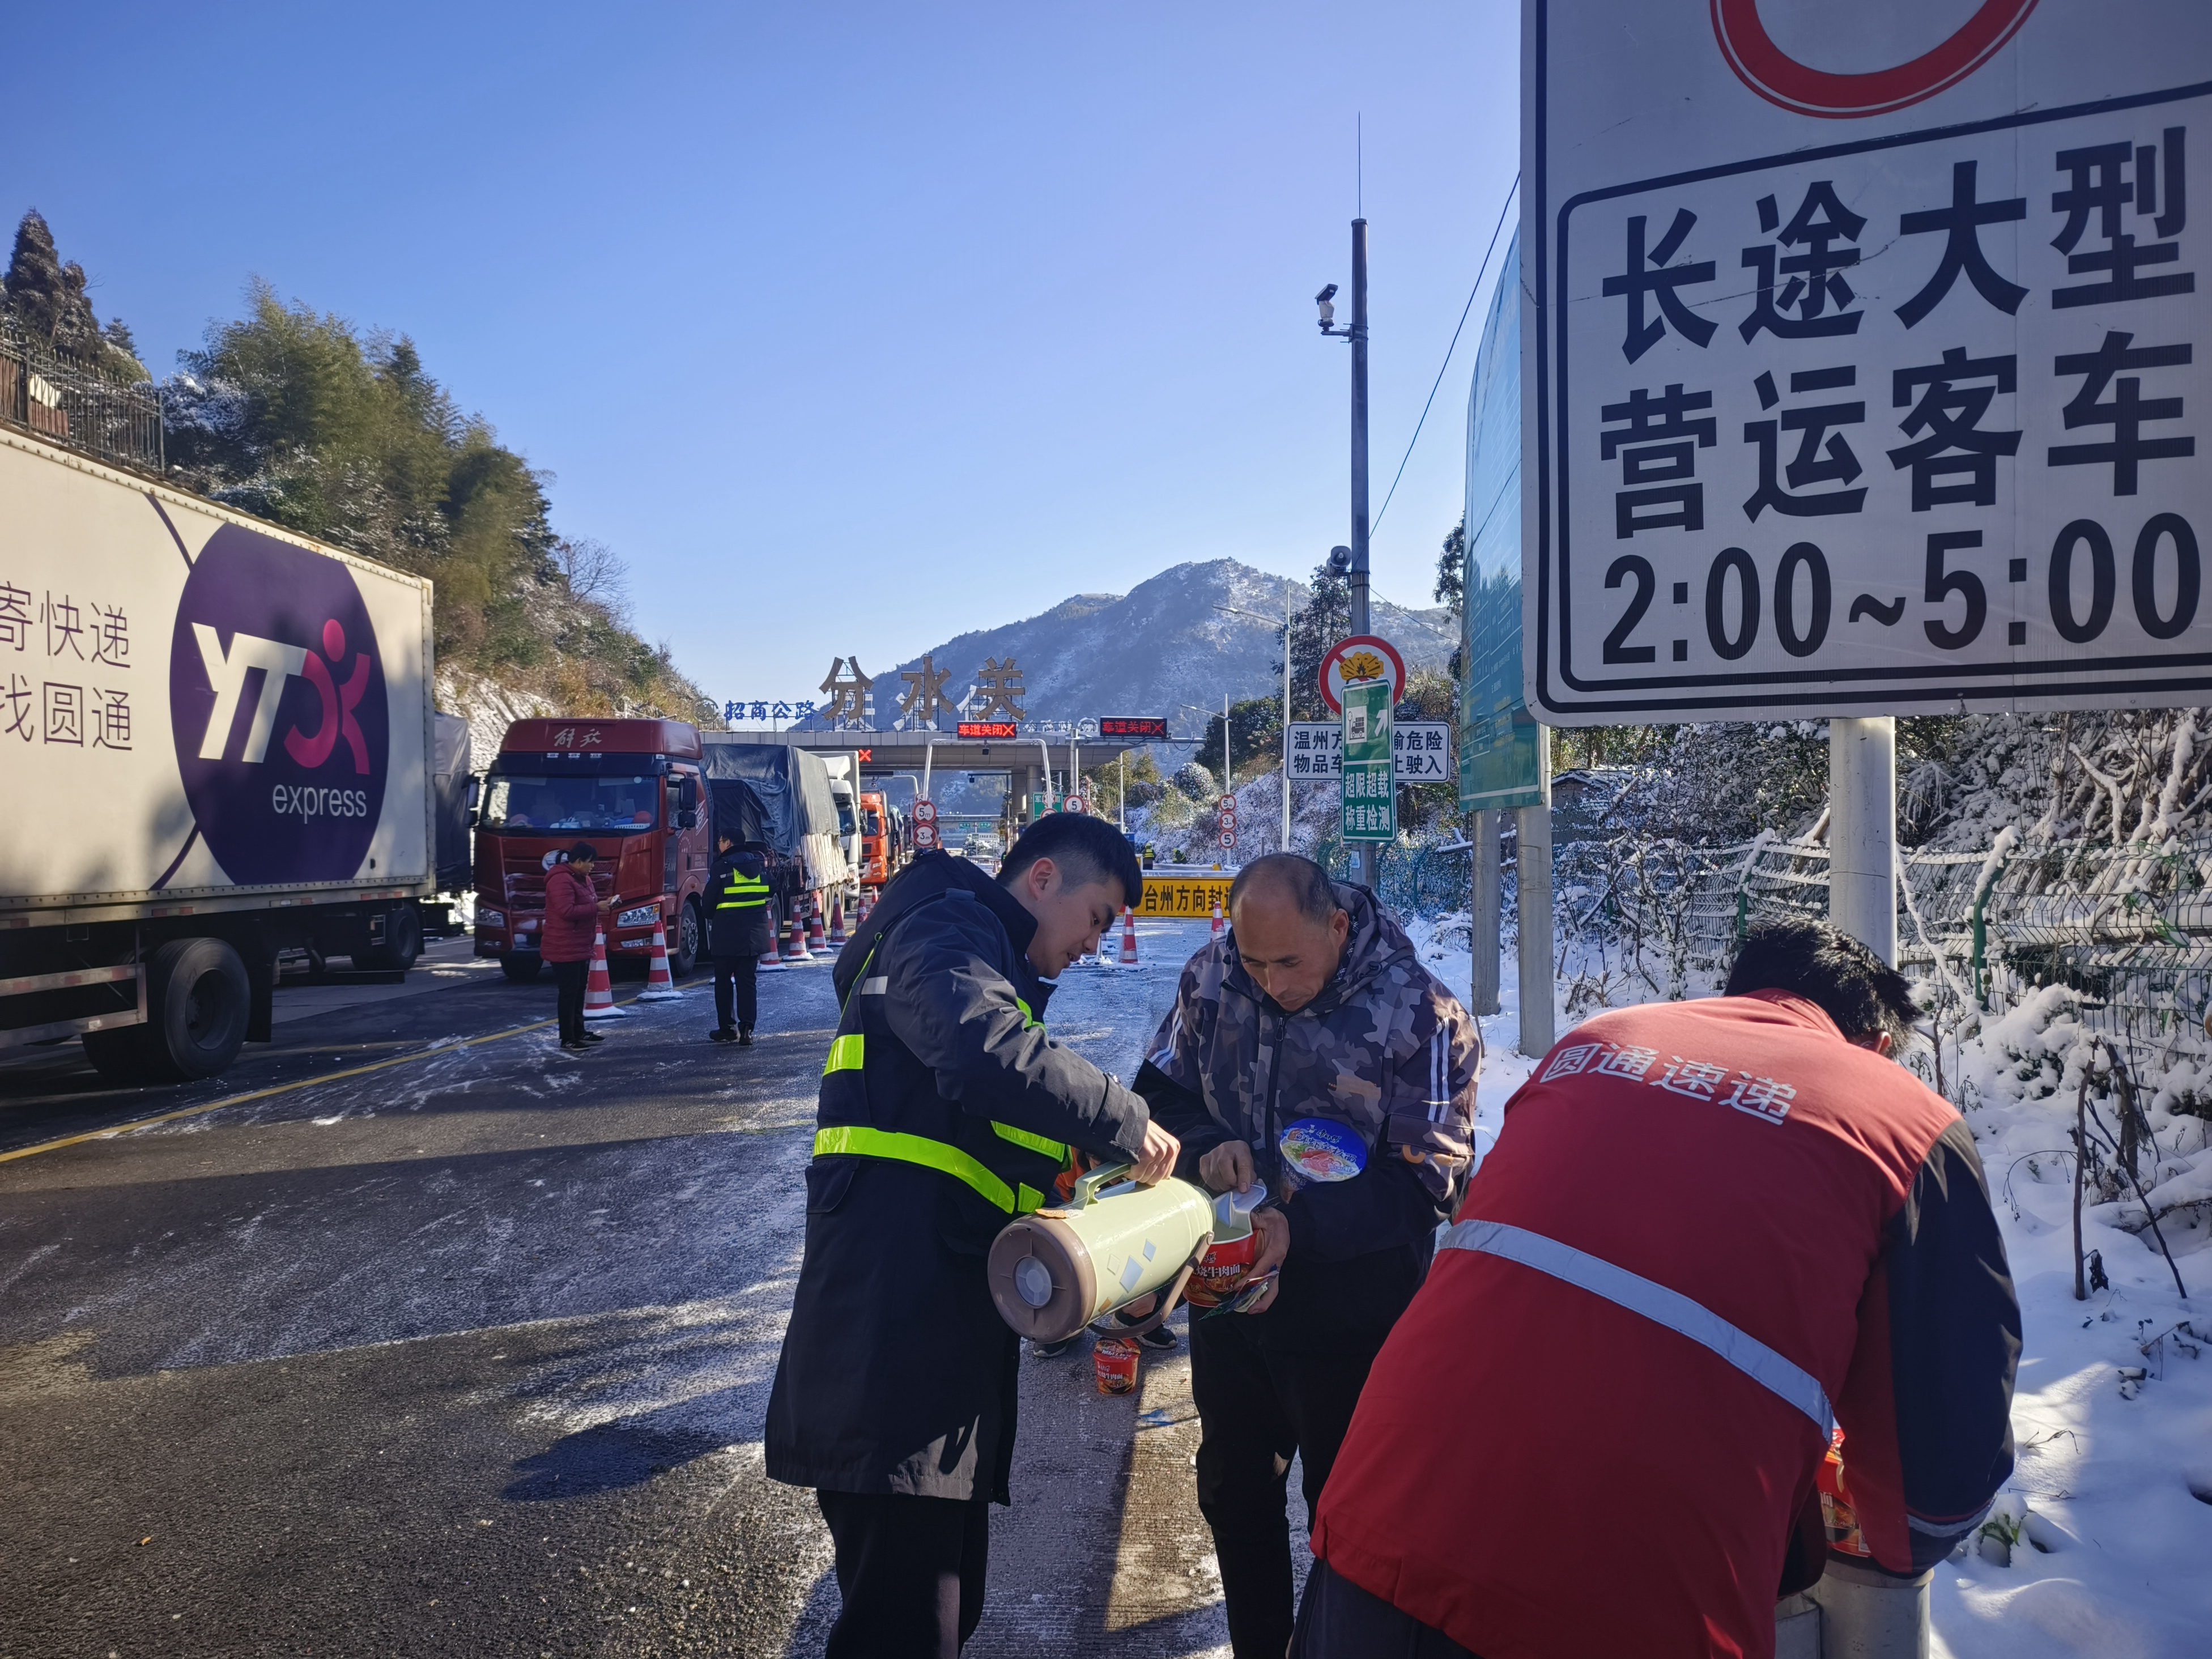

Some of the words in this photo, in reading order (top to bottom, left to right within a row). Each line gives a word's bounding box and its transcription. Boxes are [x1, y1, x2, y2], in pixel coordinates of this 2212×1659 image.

[1601, 126, 2195, 365] 长途大型
[1599, 331, 2196, 539] 营运客车
[1602, 512, 2201, 665] 2:00~5:00
[819, 656, 1027, 721] 分水关
[724, 700, 815, 721] 招商公路
[554, 728, 602, 748] 解放
[959, 724, 1002, 735] 车道关闭
[1345, 771, 1389, 798] 超限超载
[272, 784, 367, 824] express
[919, 807, 930, 817] 5m
[1071, 801, 1077, 810] 5
[1345, 805, 1390, 831] 称重检测
[1224, 834, 1231, 844] 5
[1539, 1043, 1797, 1126] 圆通速递
[1193, 1264, 1241, 1278] 烧牛肉面
